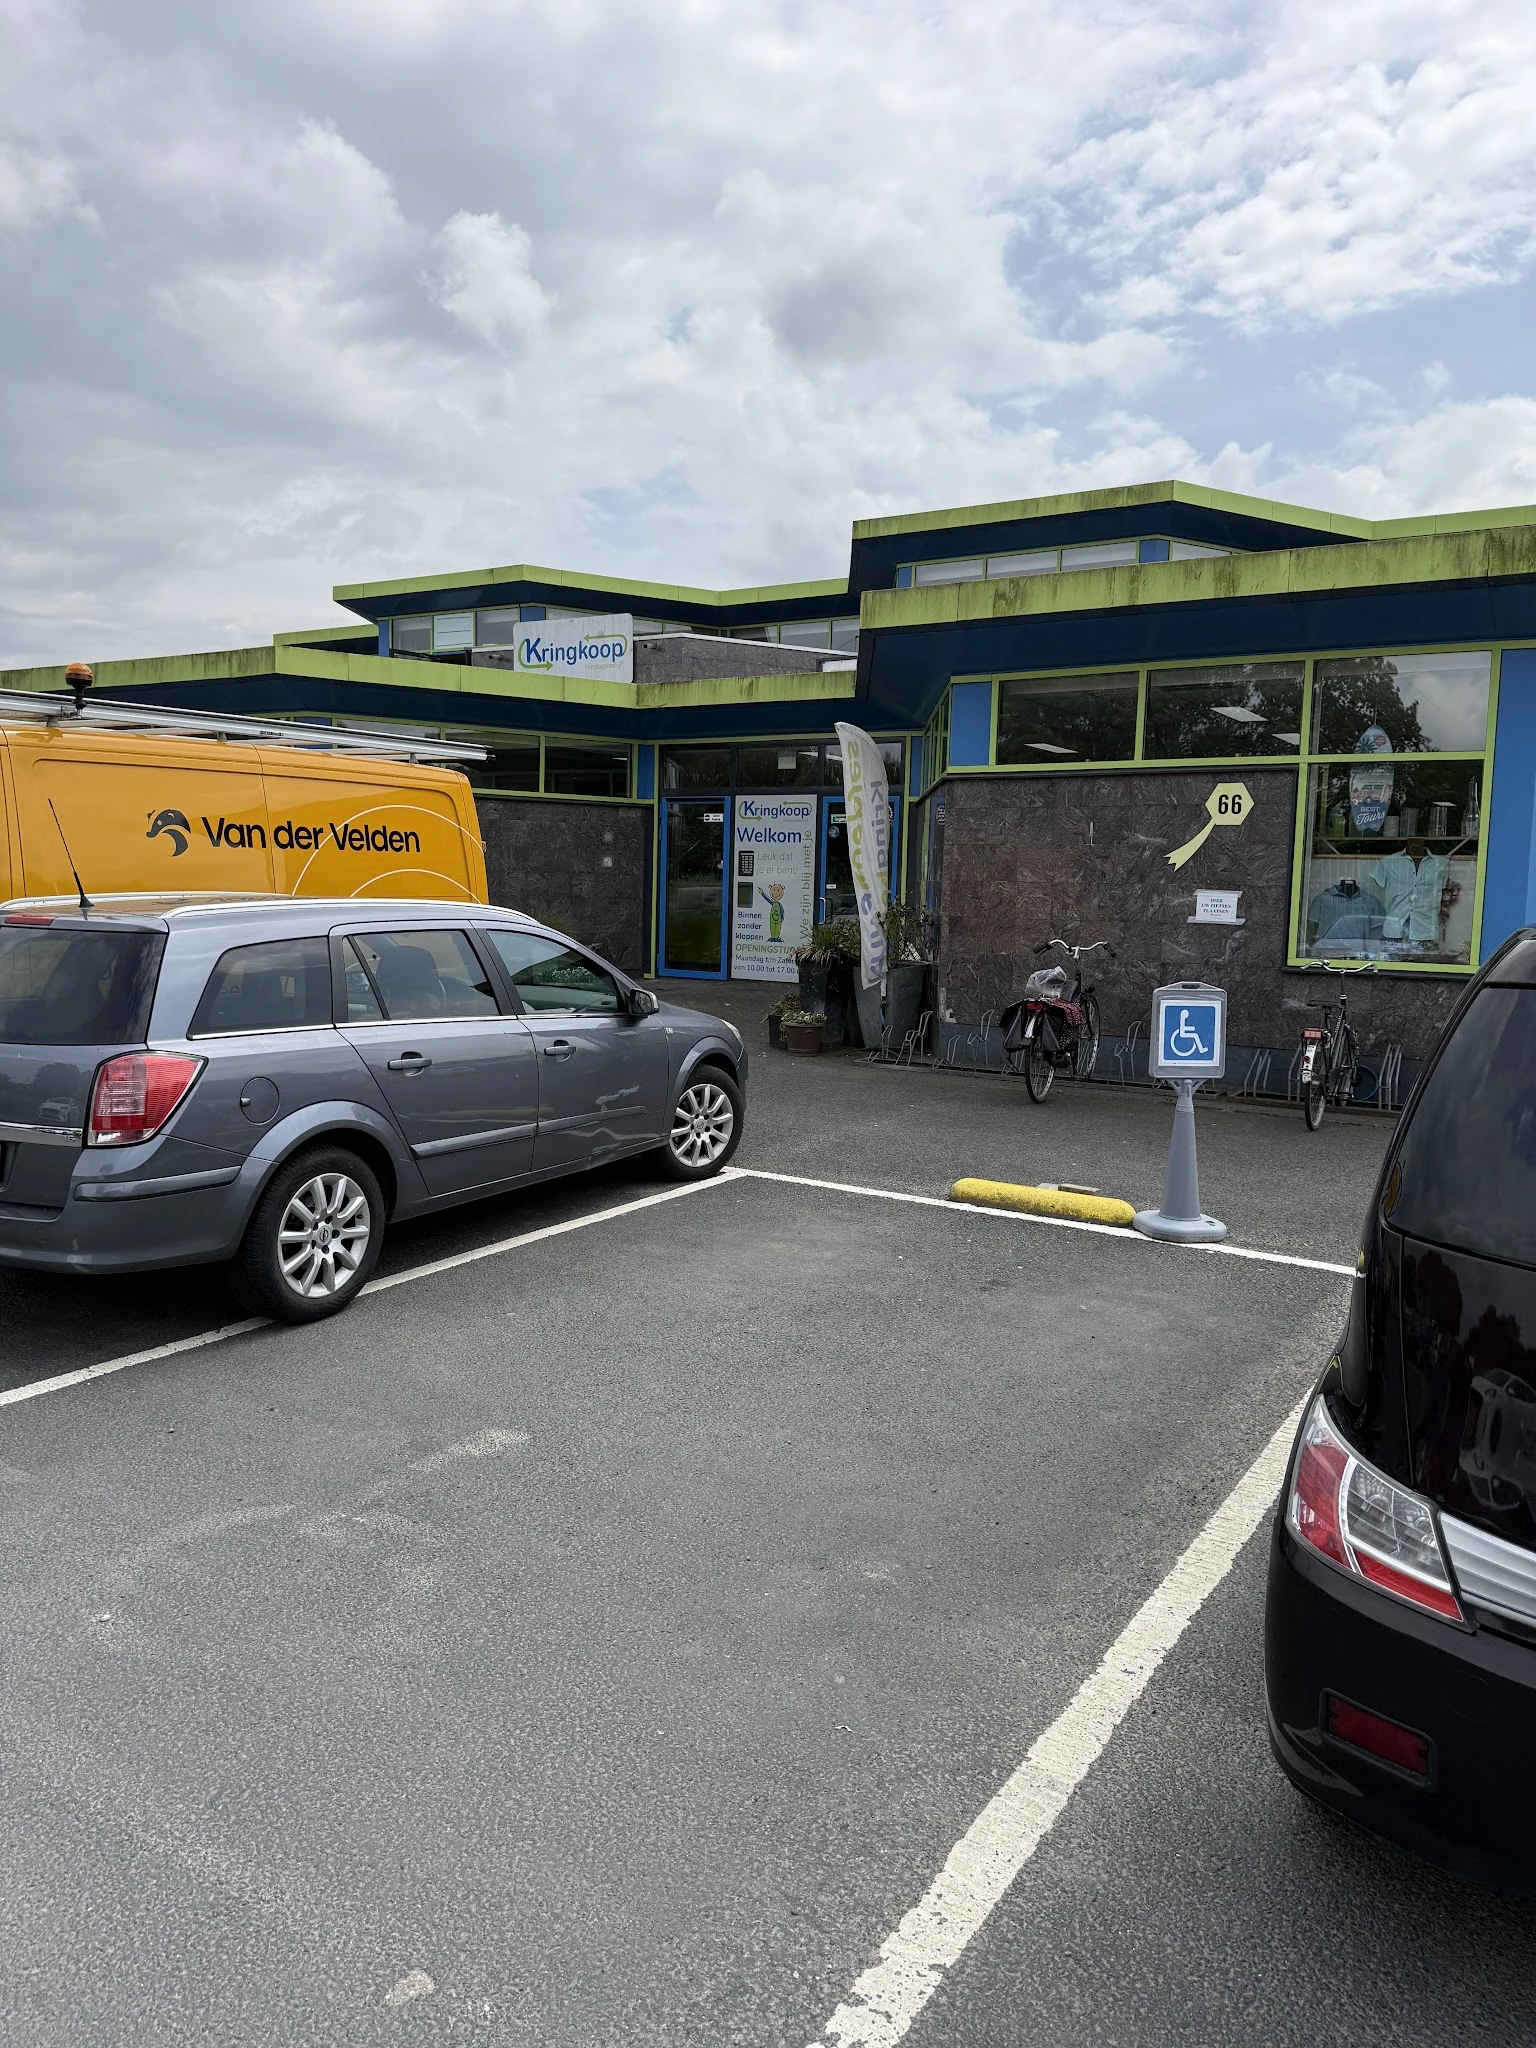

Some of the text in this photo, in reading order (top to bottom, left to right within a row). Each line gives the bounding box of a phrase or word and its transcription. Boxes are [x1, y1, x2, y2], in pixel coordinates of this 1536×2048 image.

[525, 637, 625, 665] Kringkoop
[743, 800, 810, 819] Kringkoop
[1218, 794, 1242, 815] 66
[1356, 811, 1386, 825] Tours
[201, 816, 421, 853] Van der Velden
[737, 827, 802, 843] Welkom
[802, 830, 814, 842] je
[757, 852, 793, 861] Leuk dat
[803, 844, 812, 868] met
[755, 866, 764, 875] je
[776, 865, 799, 875] bent!
[801, 872, 813, 890] blij
[800, 894, 812, 915] zijn
[737, 911, 762, 919] Binnen
[737, 922, 762, 930] zonder
[735, 932, 764, 941] kloppen
[735, 954, 764, 963] Maandag
[747, 964, 765, 972] 10.00
[777, 966, 795, 974] 17.00
